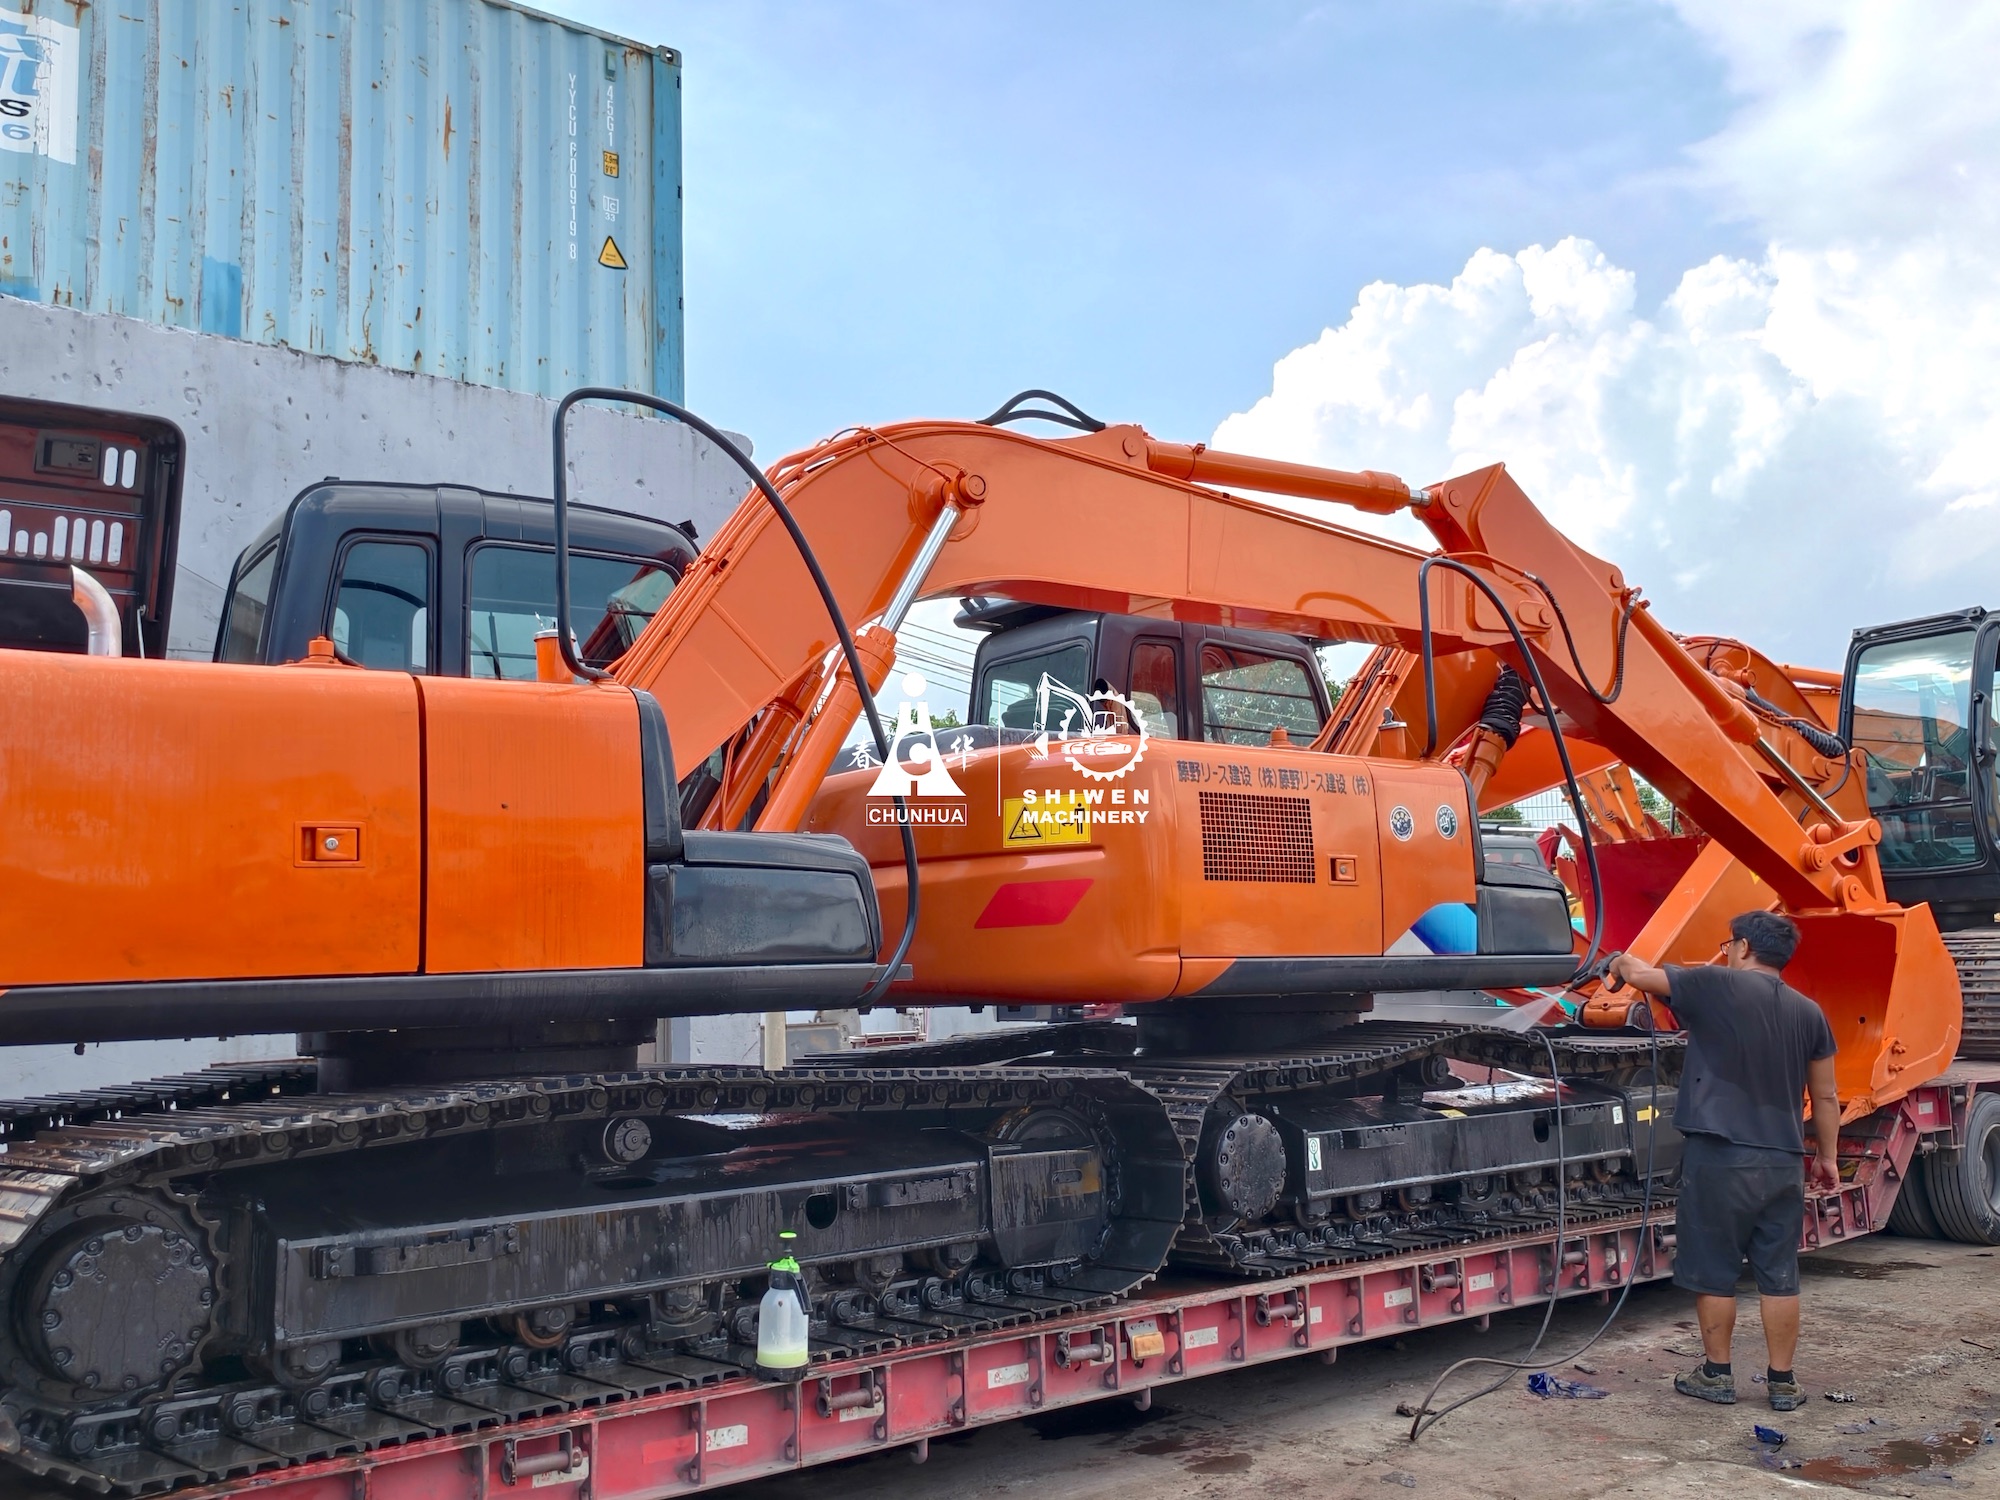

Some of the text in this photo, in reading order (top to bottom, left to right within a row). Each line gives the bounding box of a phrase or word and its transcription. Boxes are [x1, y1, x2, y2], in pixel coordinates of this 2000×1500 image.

[568, 73, 578, 136] YYCU
[606, 85, 614, 147] 45G1
[605, 212, 616, 222] 33
[569, 243, 577, 260] 8
